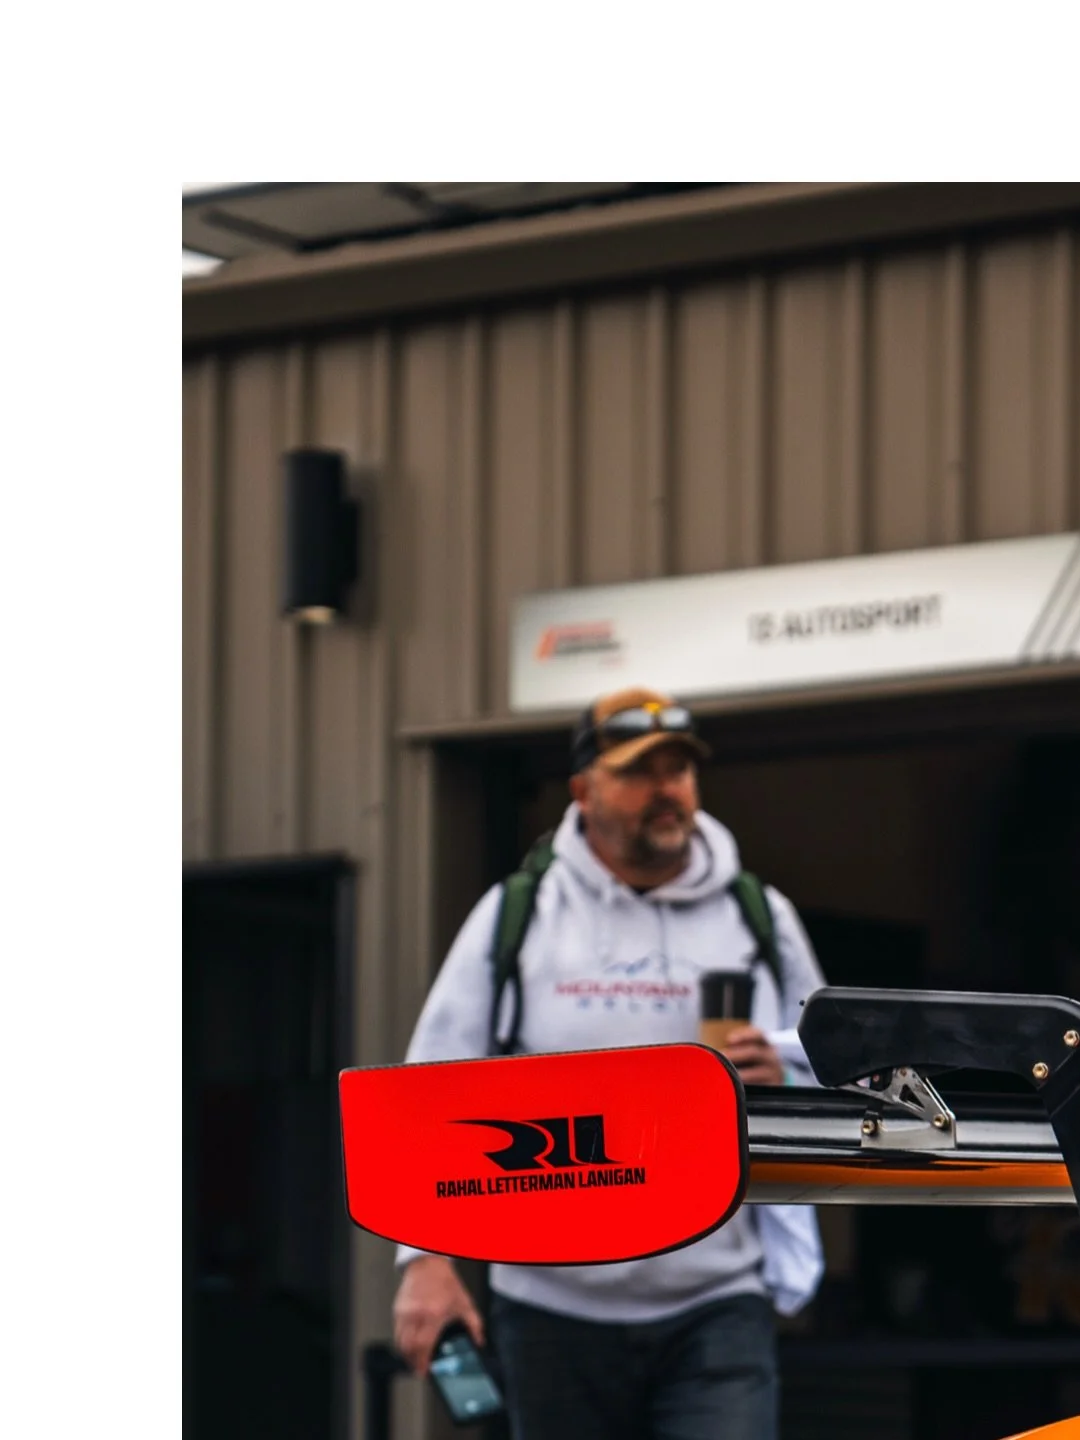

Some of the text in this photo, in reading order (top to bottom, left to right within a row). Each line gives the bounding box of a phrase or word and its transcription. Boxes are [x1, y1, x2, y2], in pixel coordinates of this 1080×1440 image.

[780, 593, 943, 641] AUTOSPORT
[436, 1167, 647, 1199] RAHAL LETTERMAN LANIGAN
